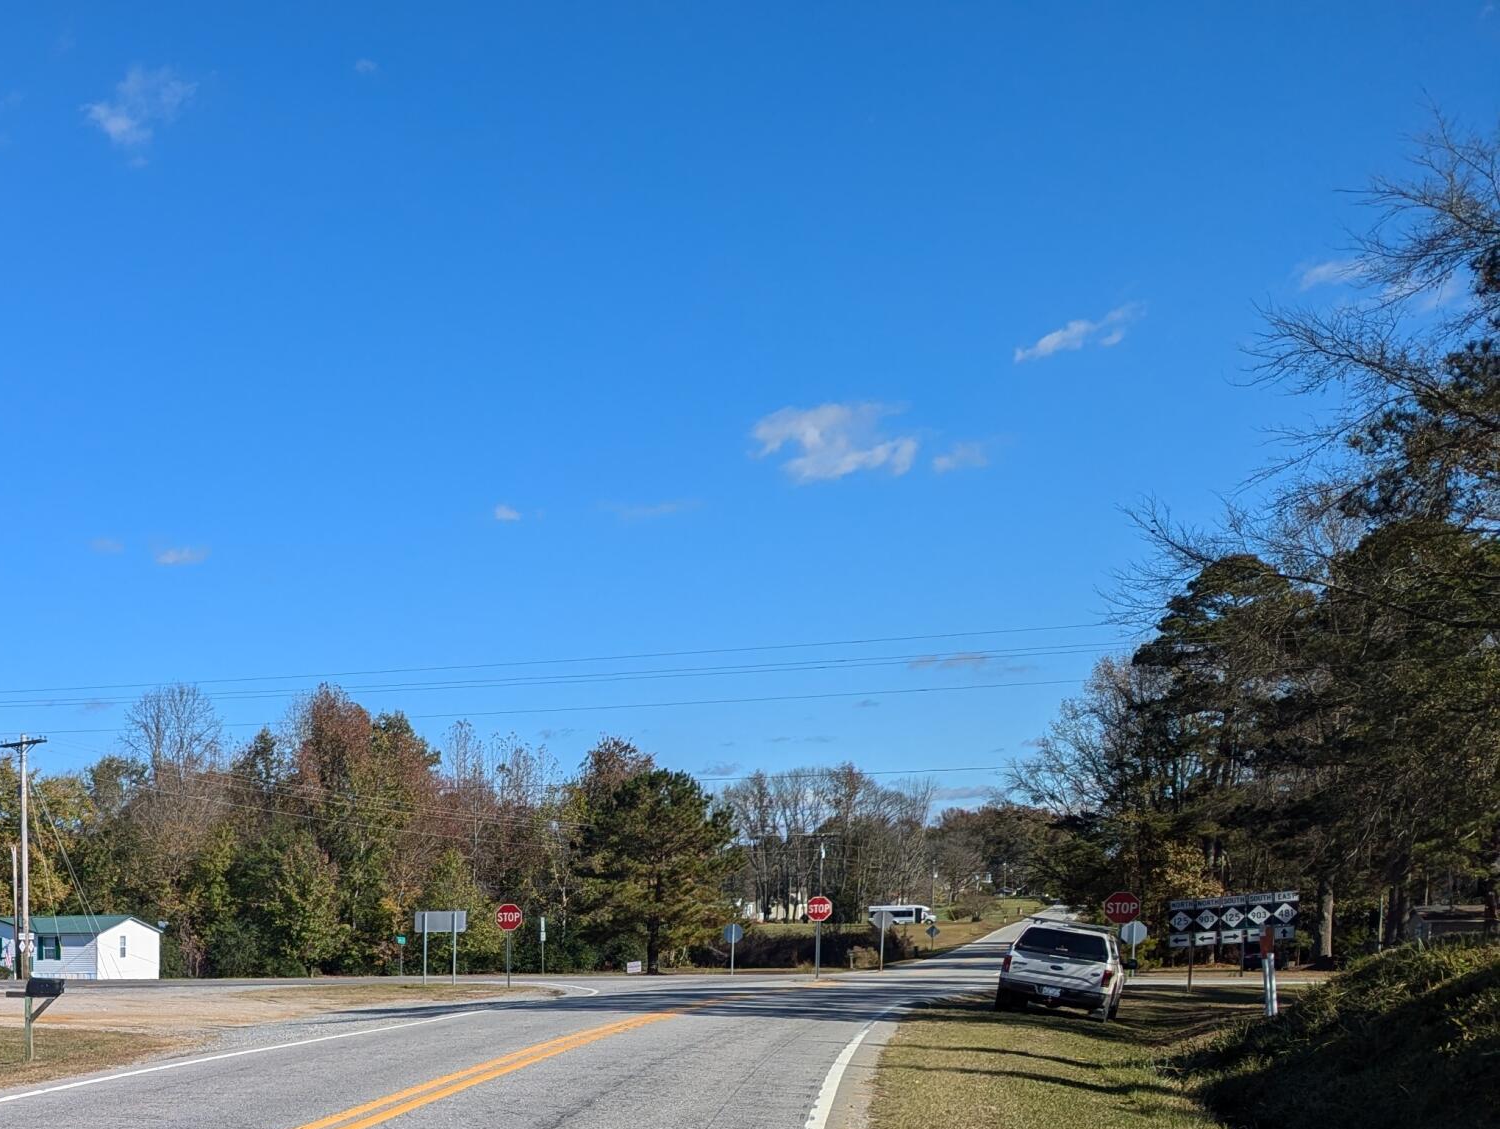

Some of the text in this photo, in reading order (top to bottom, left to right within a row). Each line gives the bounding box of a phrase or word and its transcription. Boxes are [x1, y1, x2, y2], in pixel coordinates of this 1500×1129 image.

[1223, 896, 1245, 904] SOUTH
[1249, 894, 1271, 902] SOUTH
[1197, 899, 1219, 907] NORTH
[808, 904, 830, 914] STOP
[1106, 902, 1139, 914] STOP
[497, 912, 520, 922] STOP
[1251, 911, 1267, 919] 903
[1278, 909, 1294, 917] 481
[1173, 917, 1189, 926] 125
[1198, 915, 1214, 923] 903
[1224, 913, 1241, 922] 125
